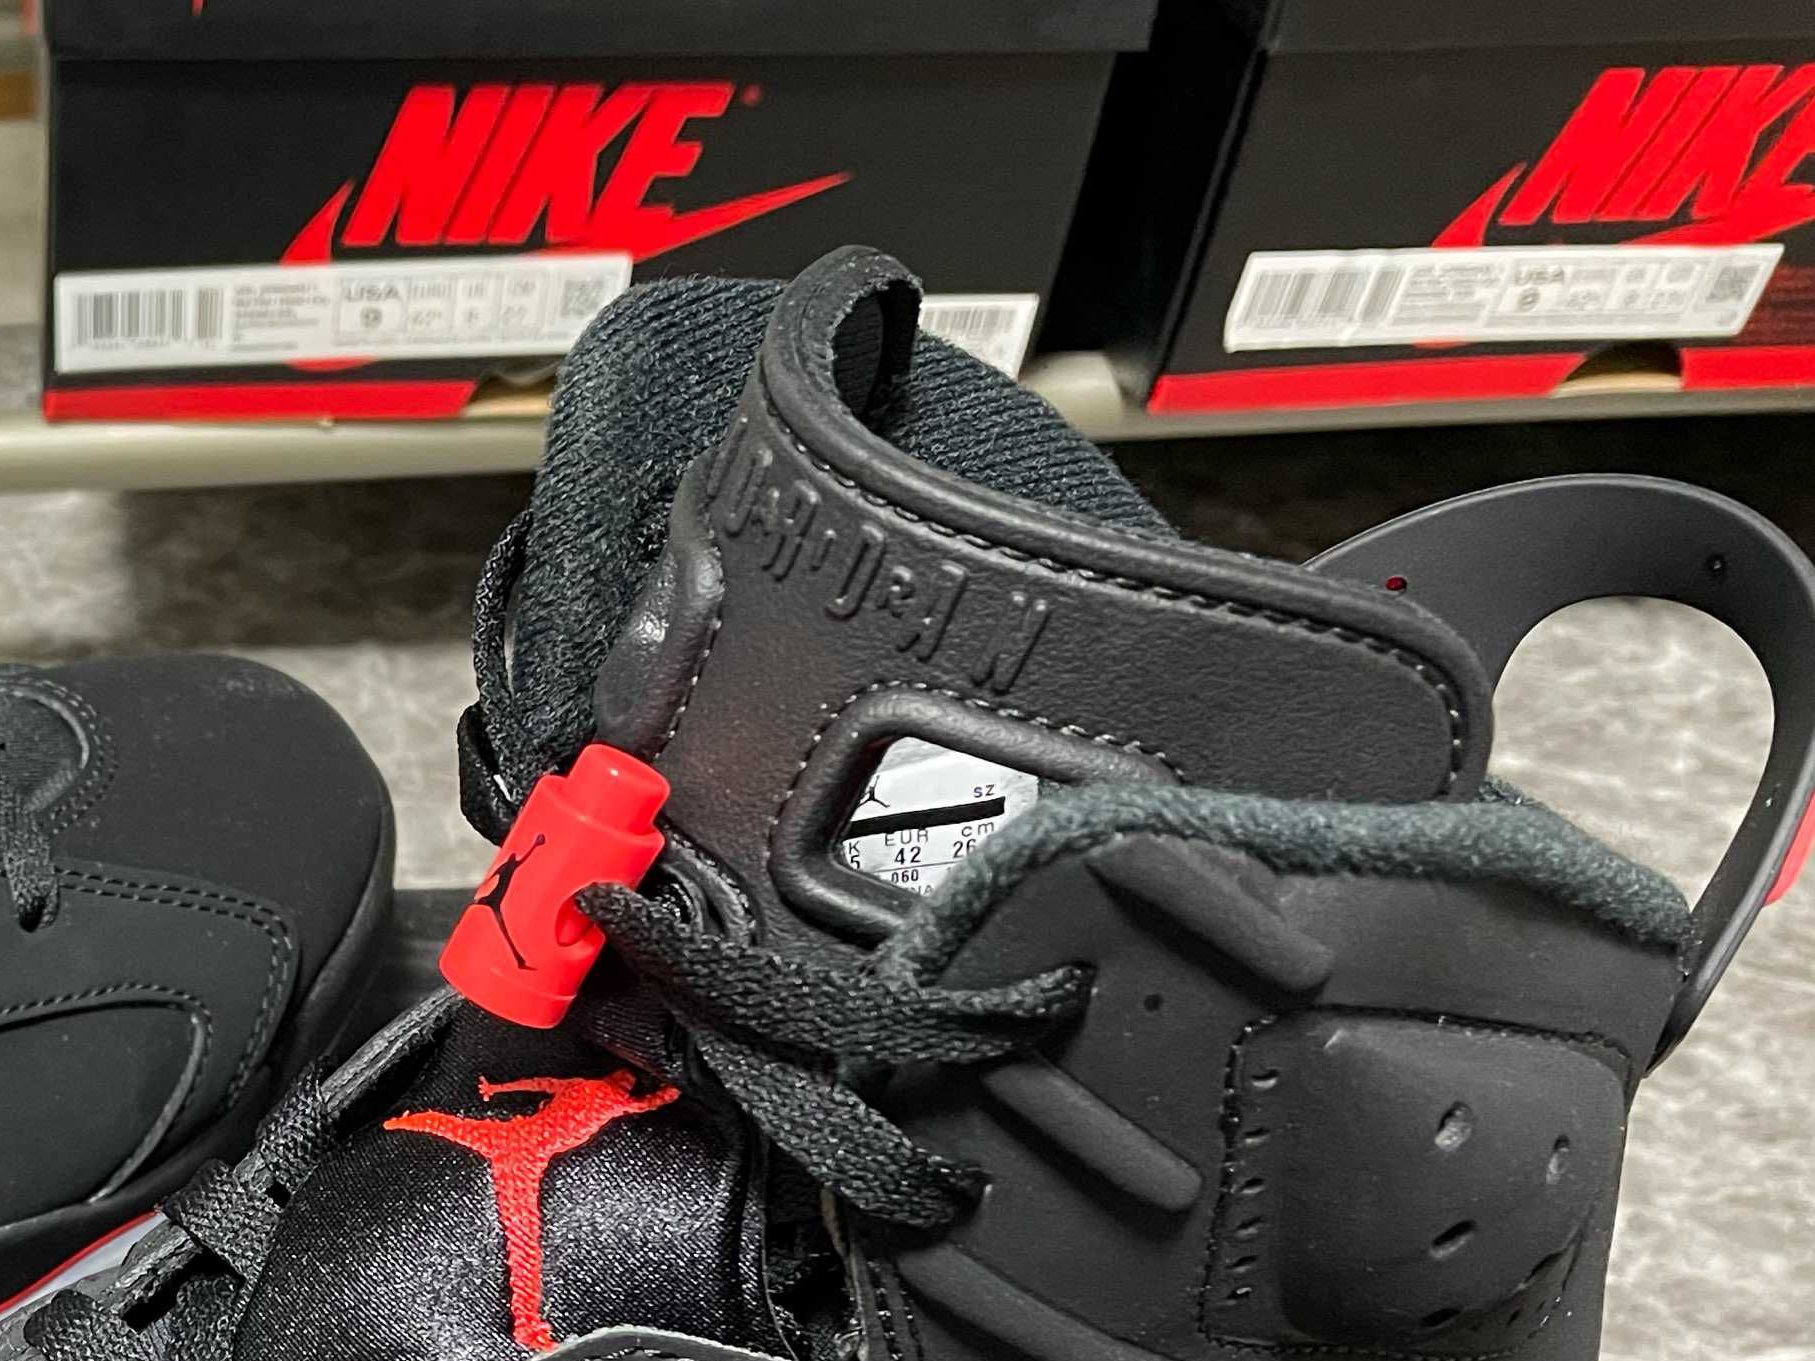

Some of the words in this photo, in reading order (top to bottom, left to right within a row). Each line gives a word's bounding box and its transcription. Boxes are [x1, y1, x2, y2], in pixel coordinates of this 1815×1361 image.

[1497, 64, 1815, 226] NIKE
[341, 82, 735, 248] NIKE
[345, 281, 400, 303] USA
[848, 840, 860, 855] K
[884, 828, 929, 847] EUR
[894, 846, 922, 865] 42
